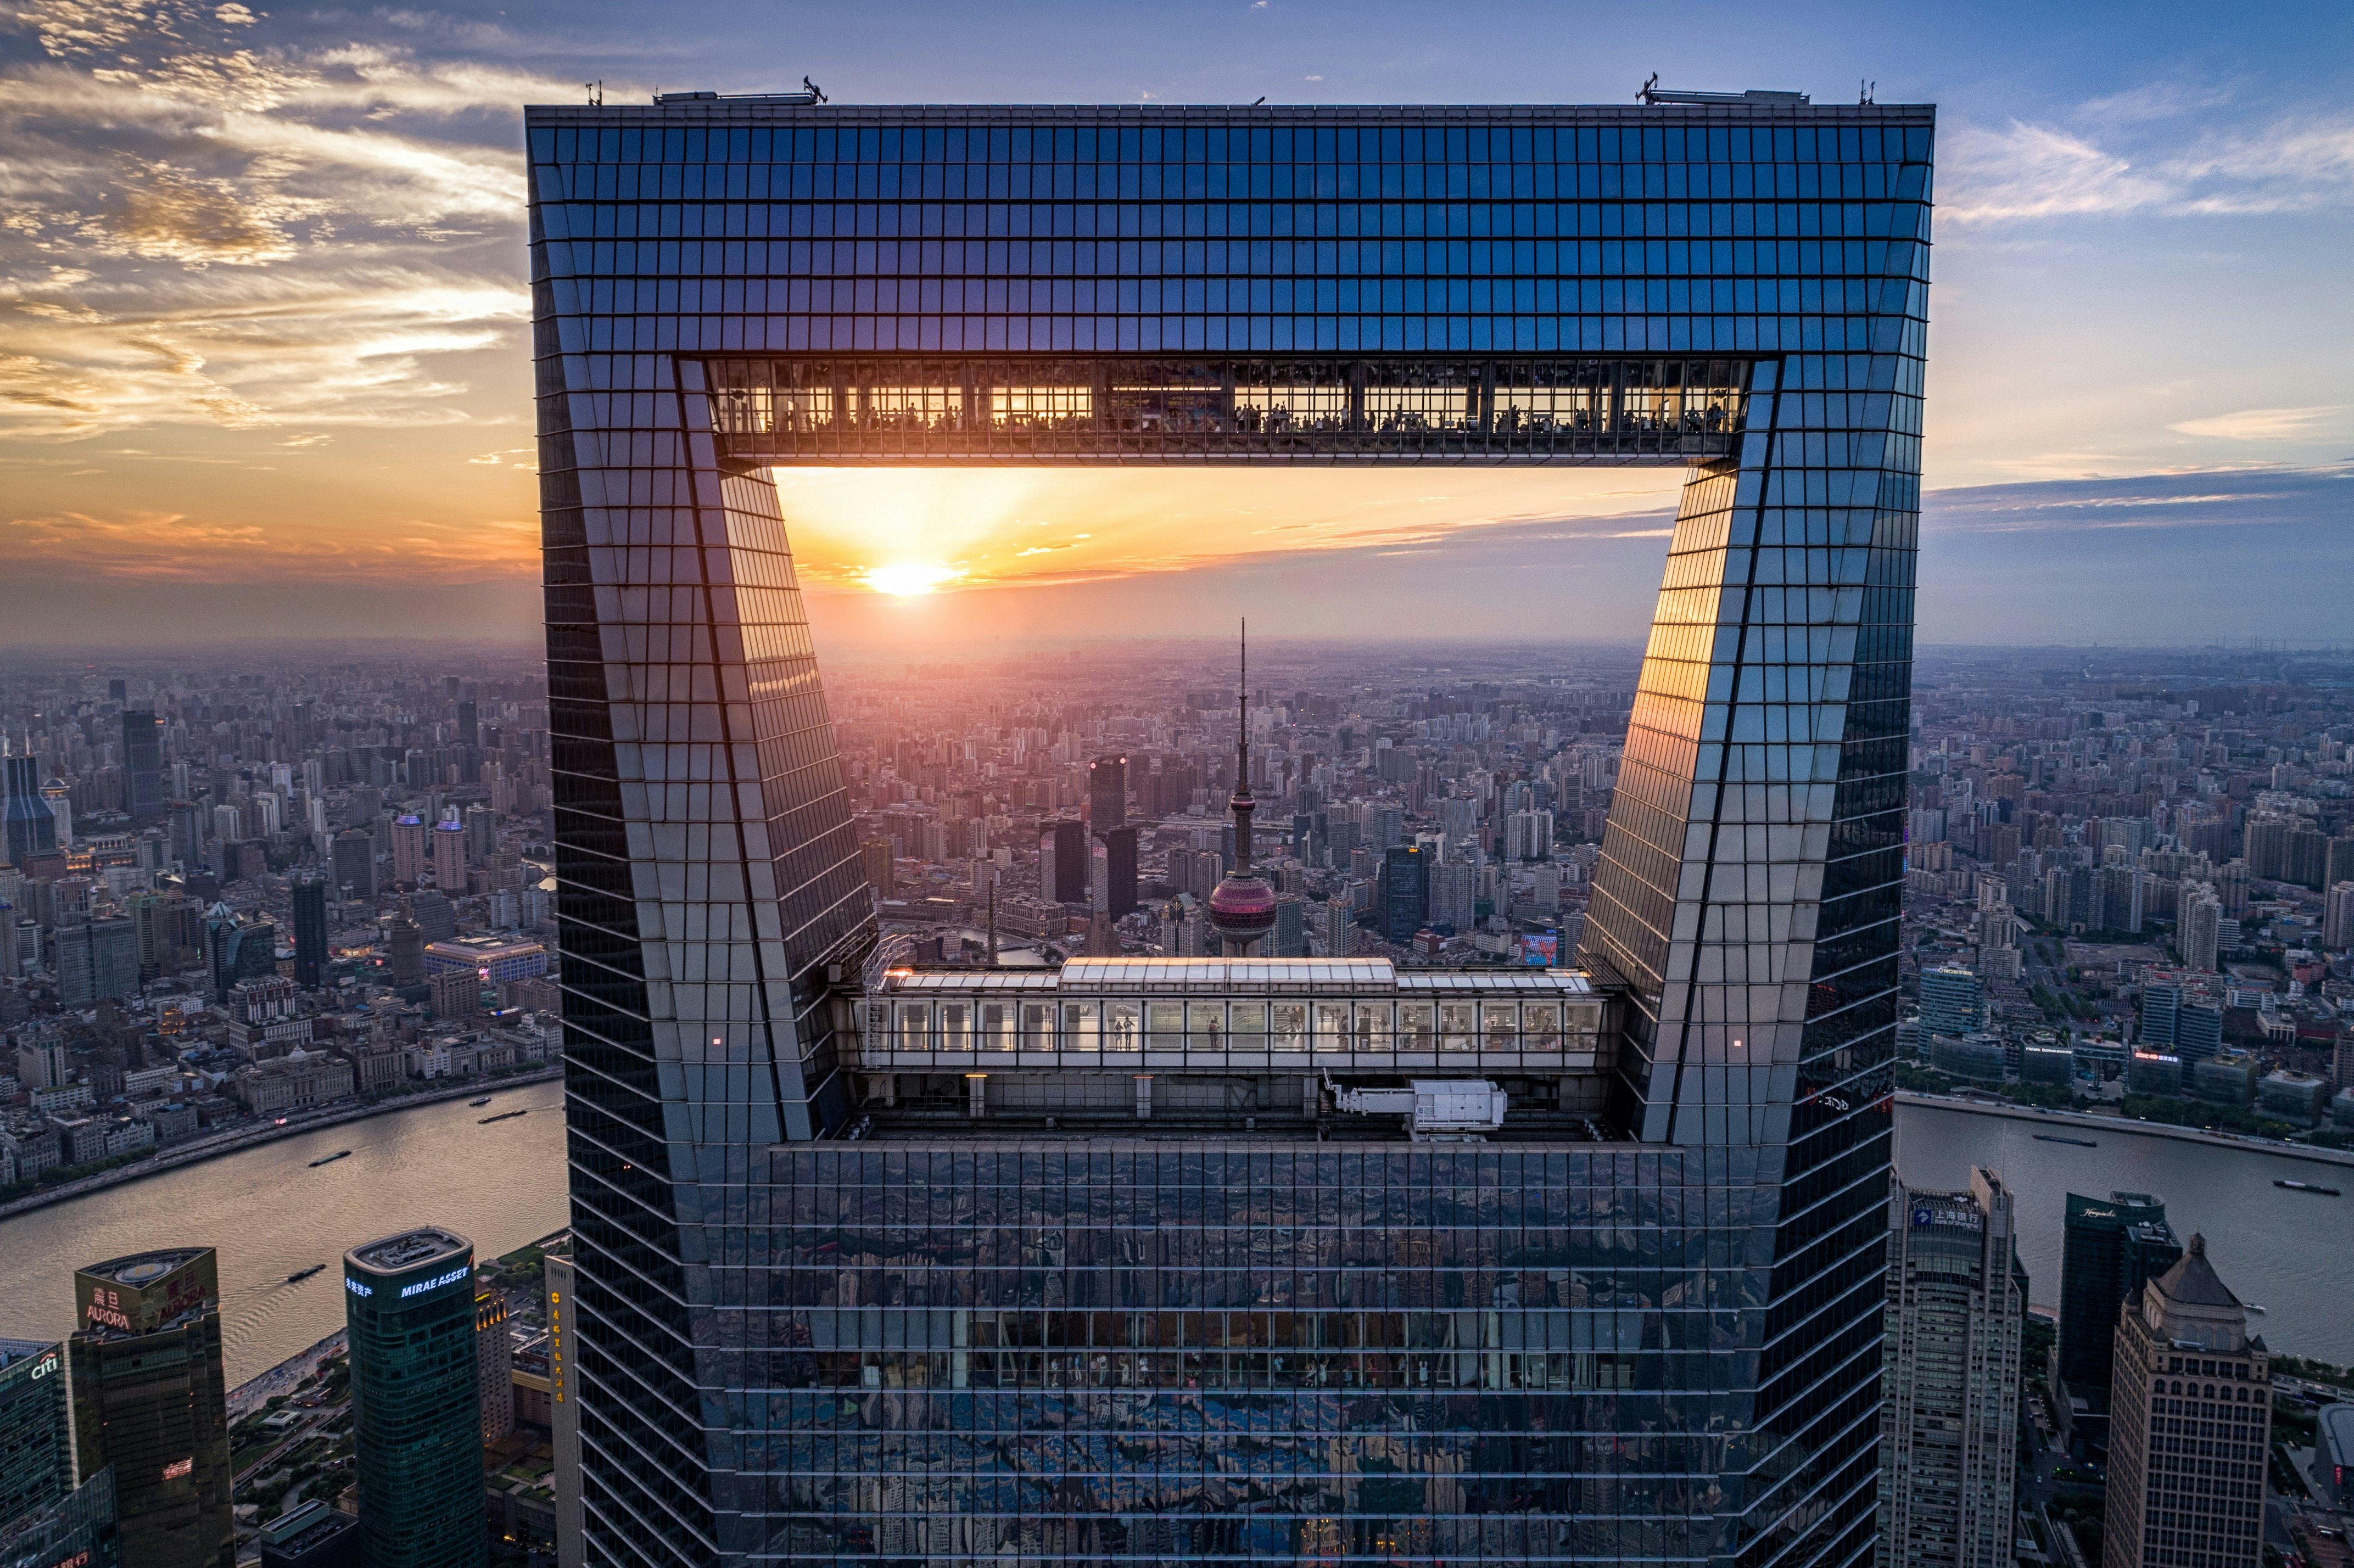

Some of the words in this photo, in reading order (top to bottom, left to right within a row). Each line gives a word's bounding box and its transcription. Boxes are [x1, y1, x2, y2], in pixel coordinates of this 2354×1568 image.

[1934, 1209, 1979, 1223] 上海银行
[1955, 1220, 1978, 1229] Shanghai
[346, 1277, 372, 1297] 未来资产
[401, 1278, 438, 1298] MIRAE
[438, 1267, 469, 1287] ASSET
[93, 1287, 119, 1310] 震旦
[159, 1286, 206, 1324] AURORA
[87, 1305, 130, 1330] AURORA
[552, 1309, 564, 1403] 香格里拉大酒店
[31, 1358, 57, 1380] citi
